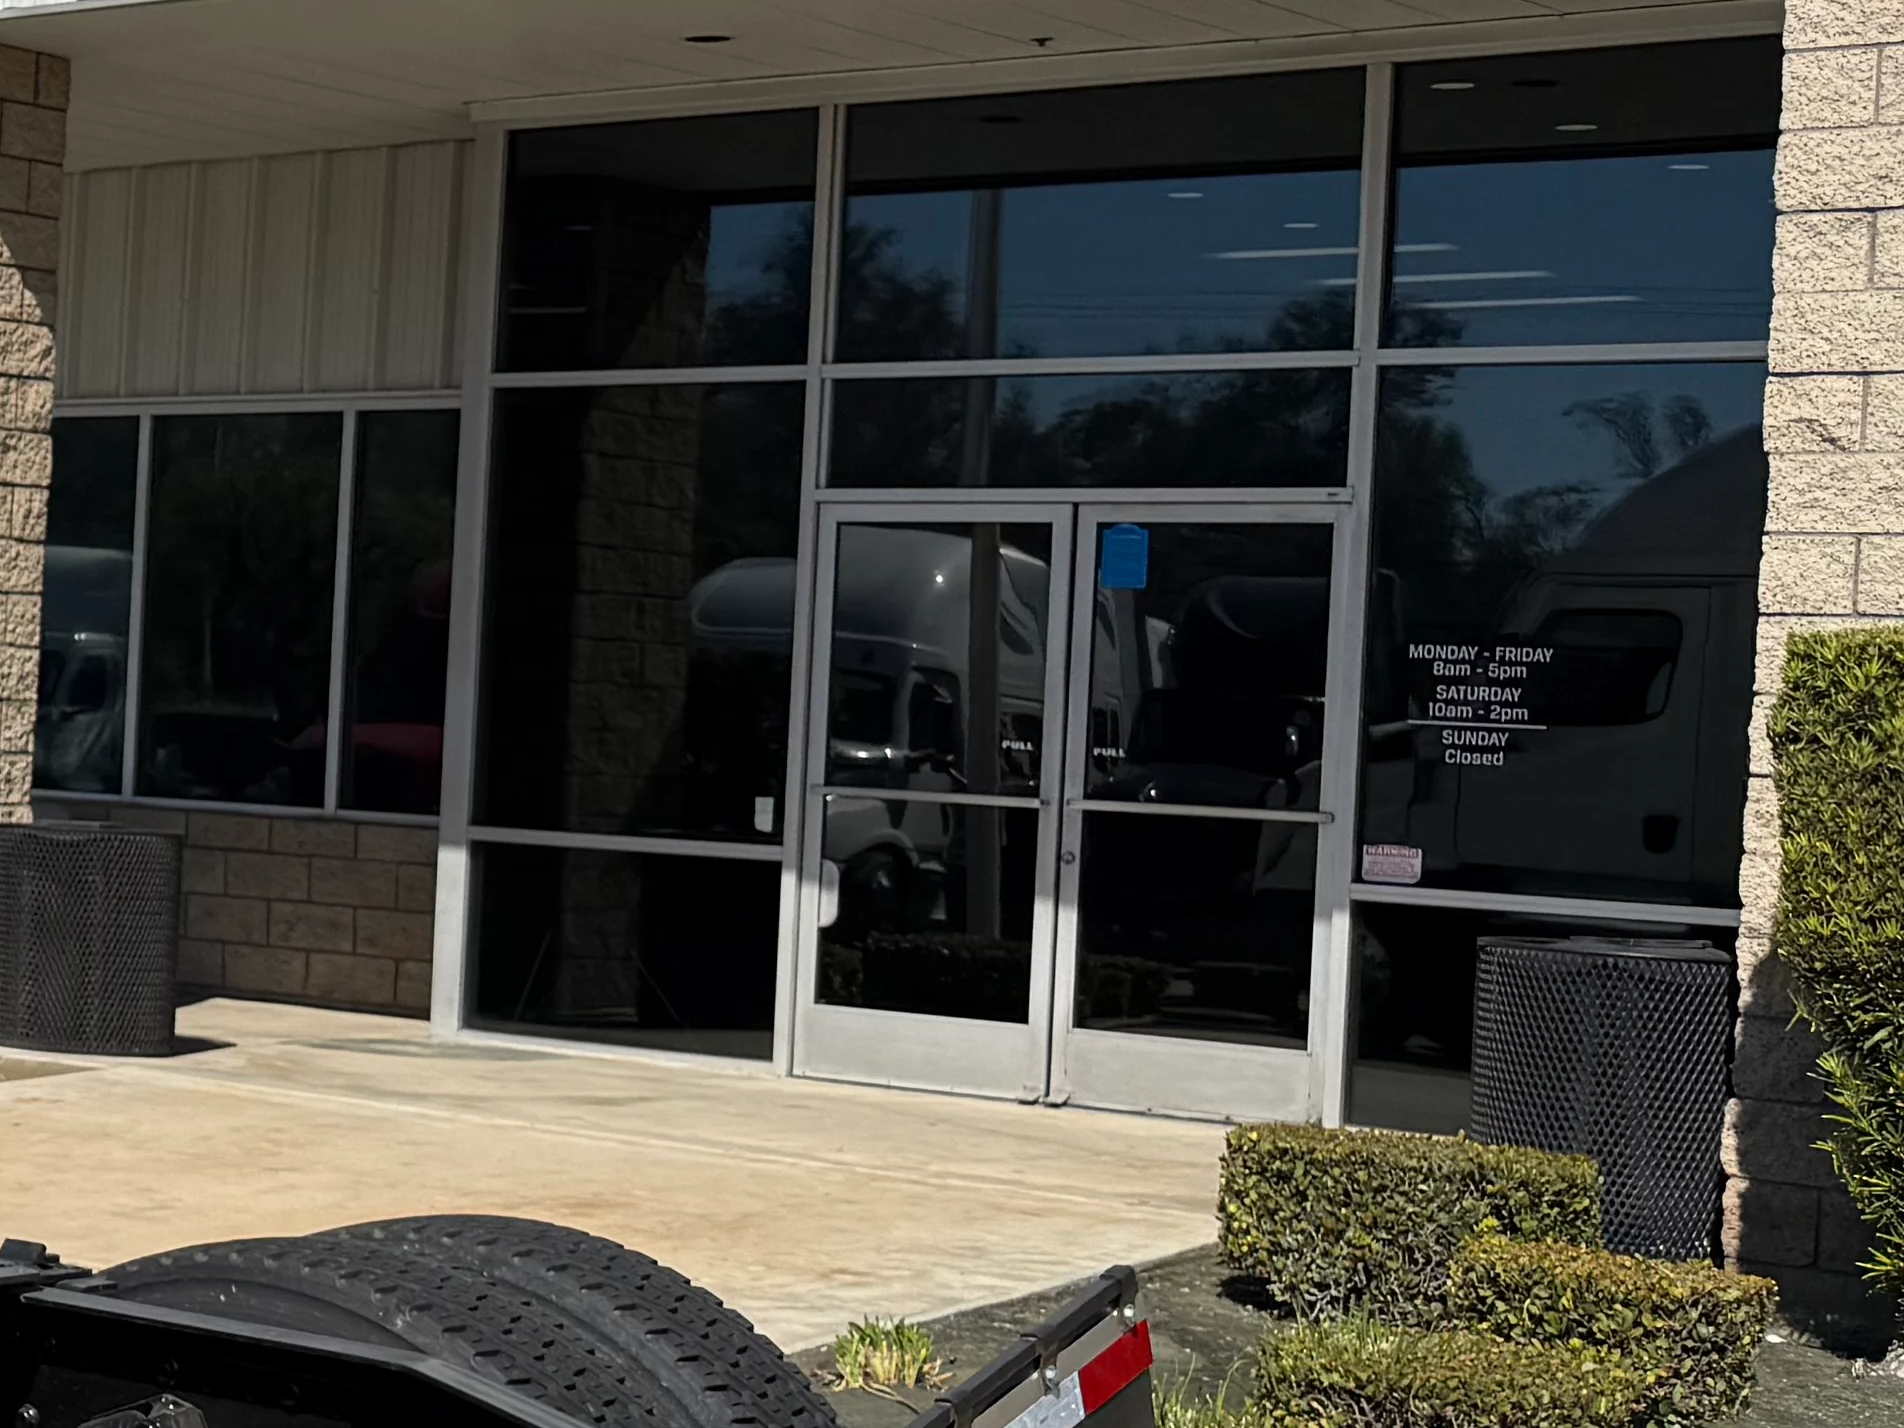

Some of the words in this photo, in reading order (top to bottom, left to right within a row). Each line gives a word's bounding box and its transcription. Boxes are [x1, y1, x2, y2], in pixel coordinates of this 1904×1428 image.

[1409, 644, 1479, 661] MONDAY
[1495, 646, 1553, 663] FRIDAY
[1433, 661, 1471, 677] 8am
[1488, 663, 1527, 681] 5pm
[1436, 685, 1522, 703] SATURDAY
[1428, 702, 1473, 719] 10am
[1490, 705, 1528, 722] 2pm
[1442, 729, 1509, 747] SUNDAY
[1444, 749, 1504, 766] Closed
